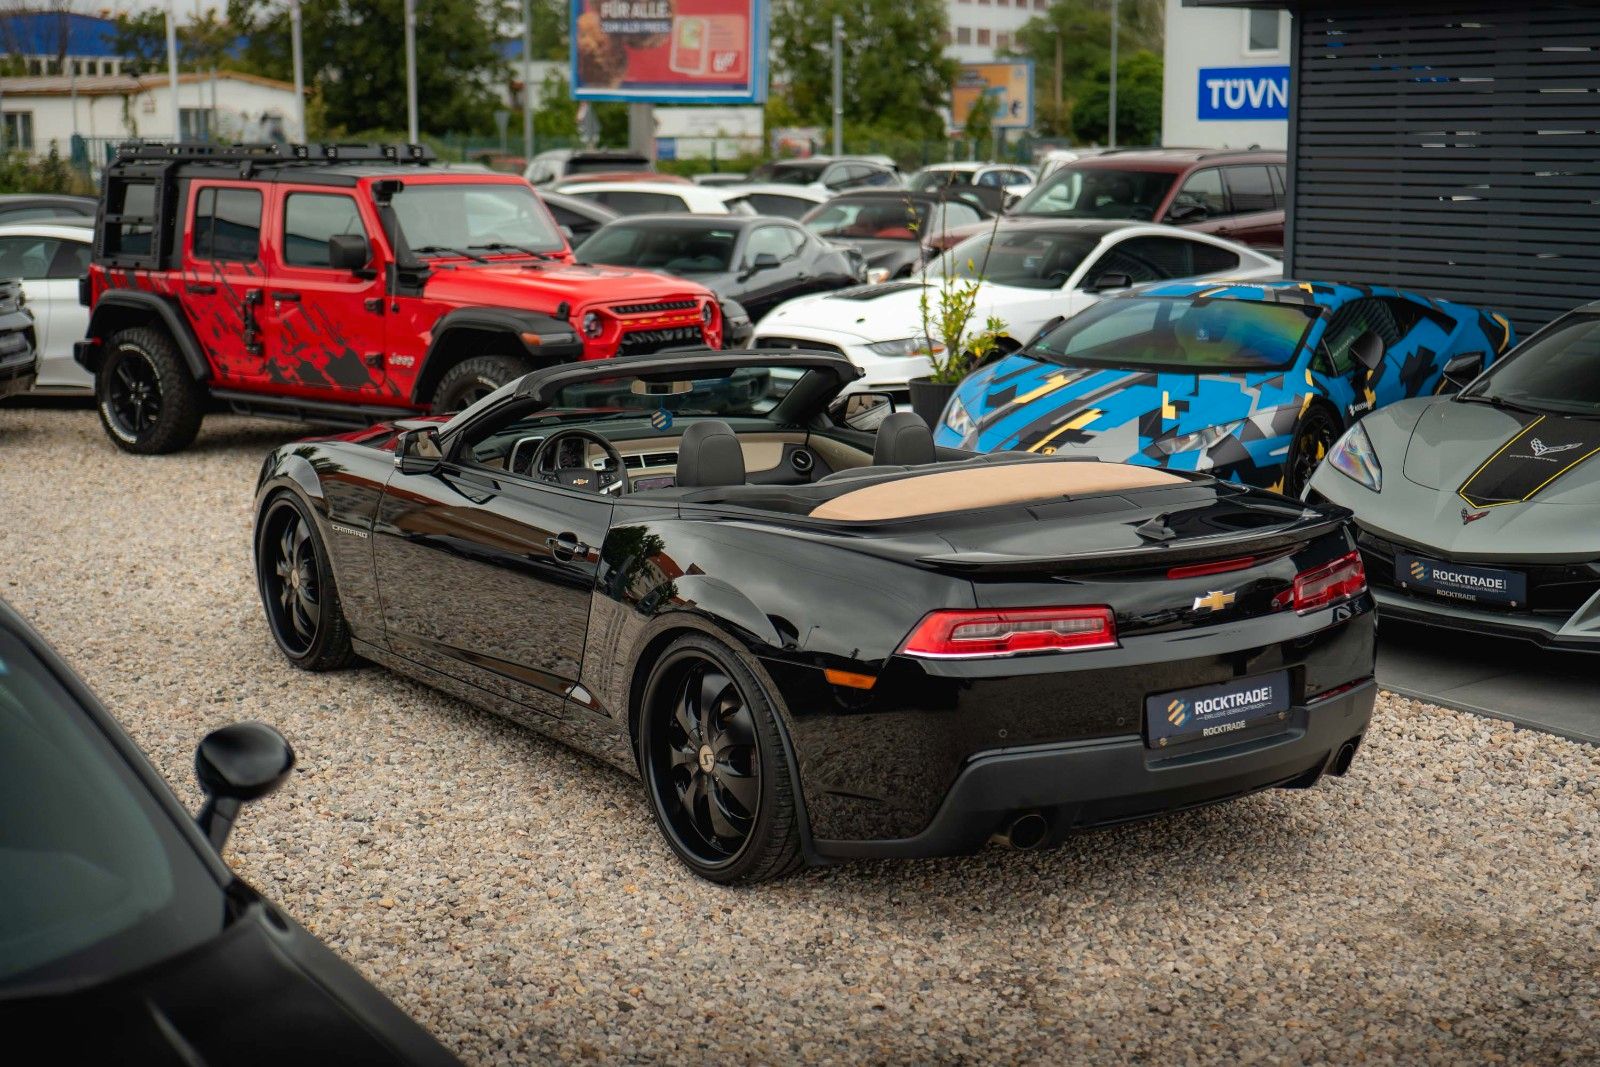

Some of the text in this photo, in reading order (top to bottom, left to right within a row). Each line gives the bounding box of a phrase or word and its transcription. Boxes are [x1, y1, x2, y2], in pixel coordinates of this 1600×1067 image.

[1206, 78, 1288, 110] TÜVN
[389, 352, 415, 368] Jeep
[331, 524, 368, 539] CAMARO
[1432, 569, 1503, 589] ROCKTRADE
[1436, 588, 1477, 601] ROCKTRADE
[1194, 687, 1269, 715] ROCKTRADE
[1203, 720, 1246, 737] ROCKTRADE
